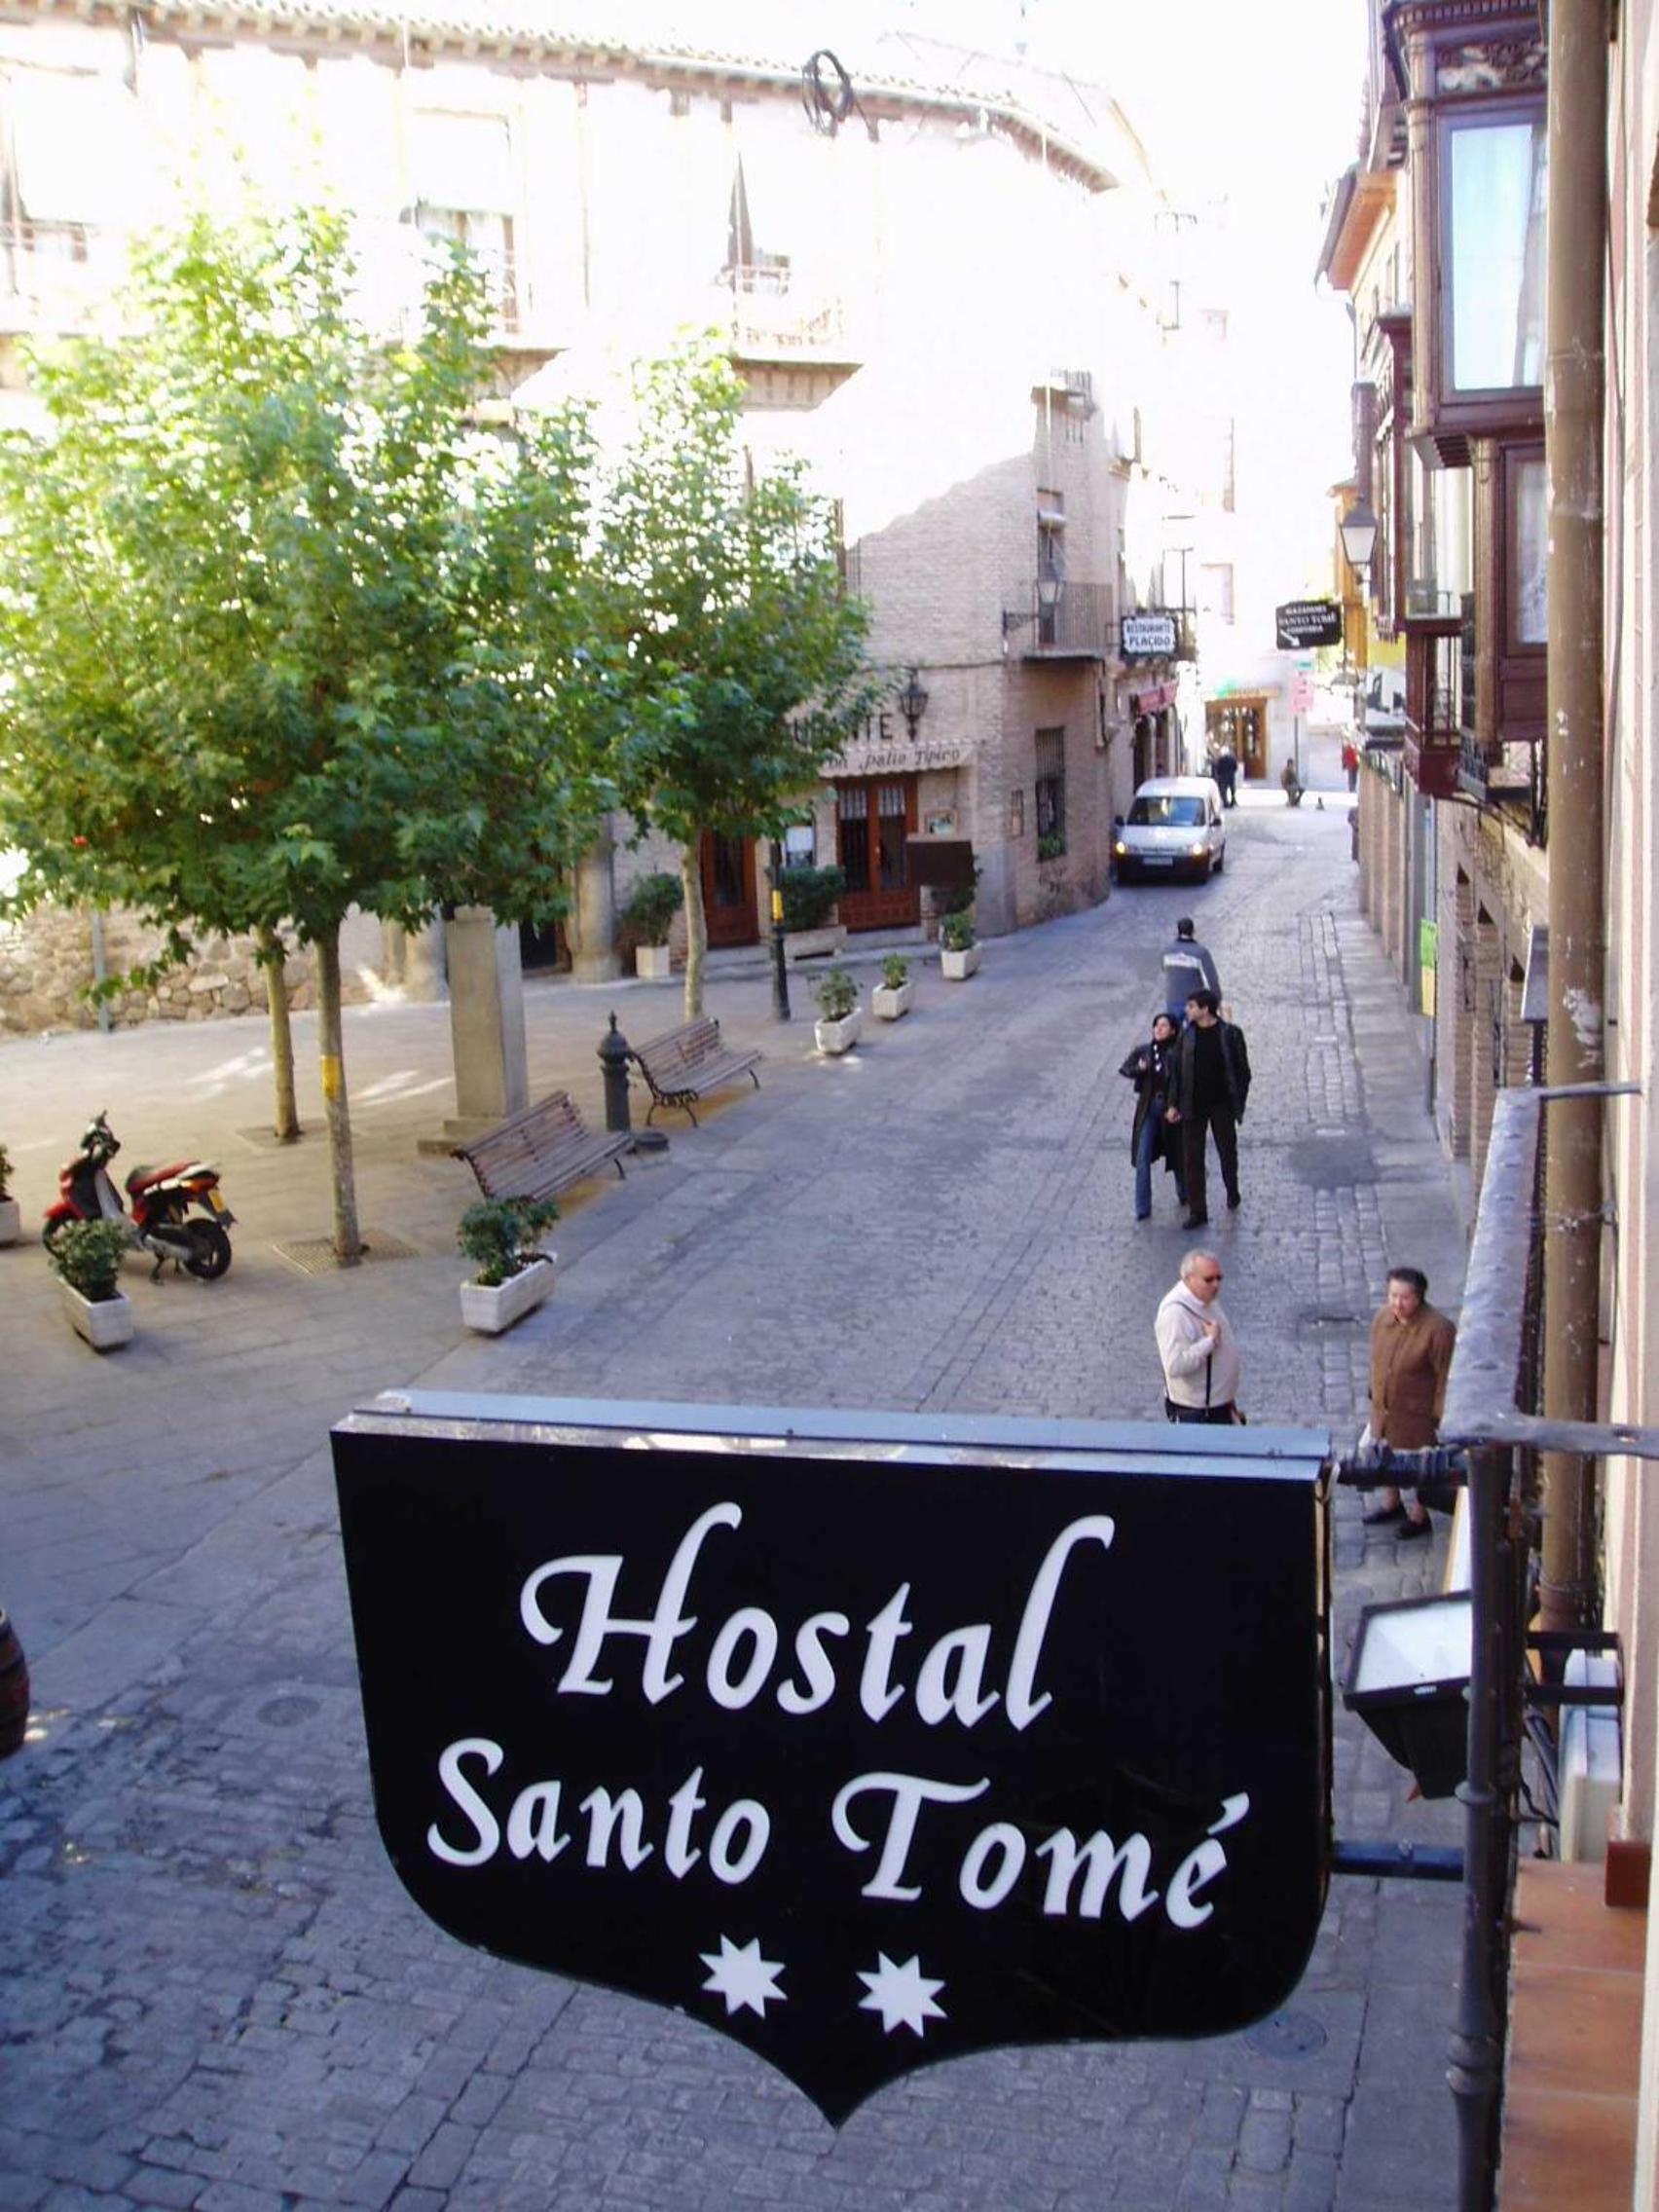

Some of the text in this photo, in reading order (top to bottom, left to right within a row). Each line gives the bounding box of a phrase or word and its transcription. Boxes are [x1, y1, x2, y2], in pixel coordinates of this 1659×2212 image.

[519, 1501, 1116, 1731] Hostal
[426, 1737, 1250, 1929] Santo Tomé
